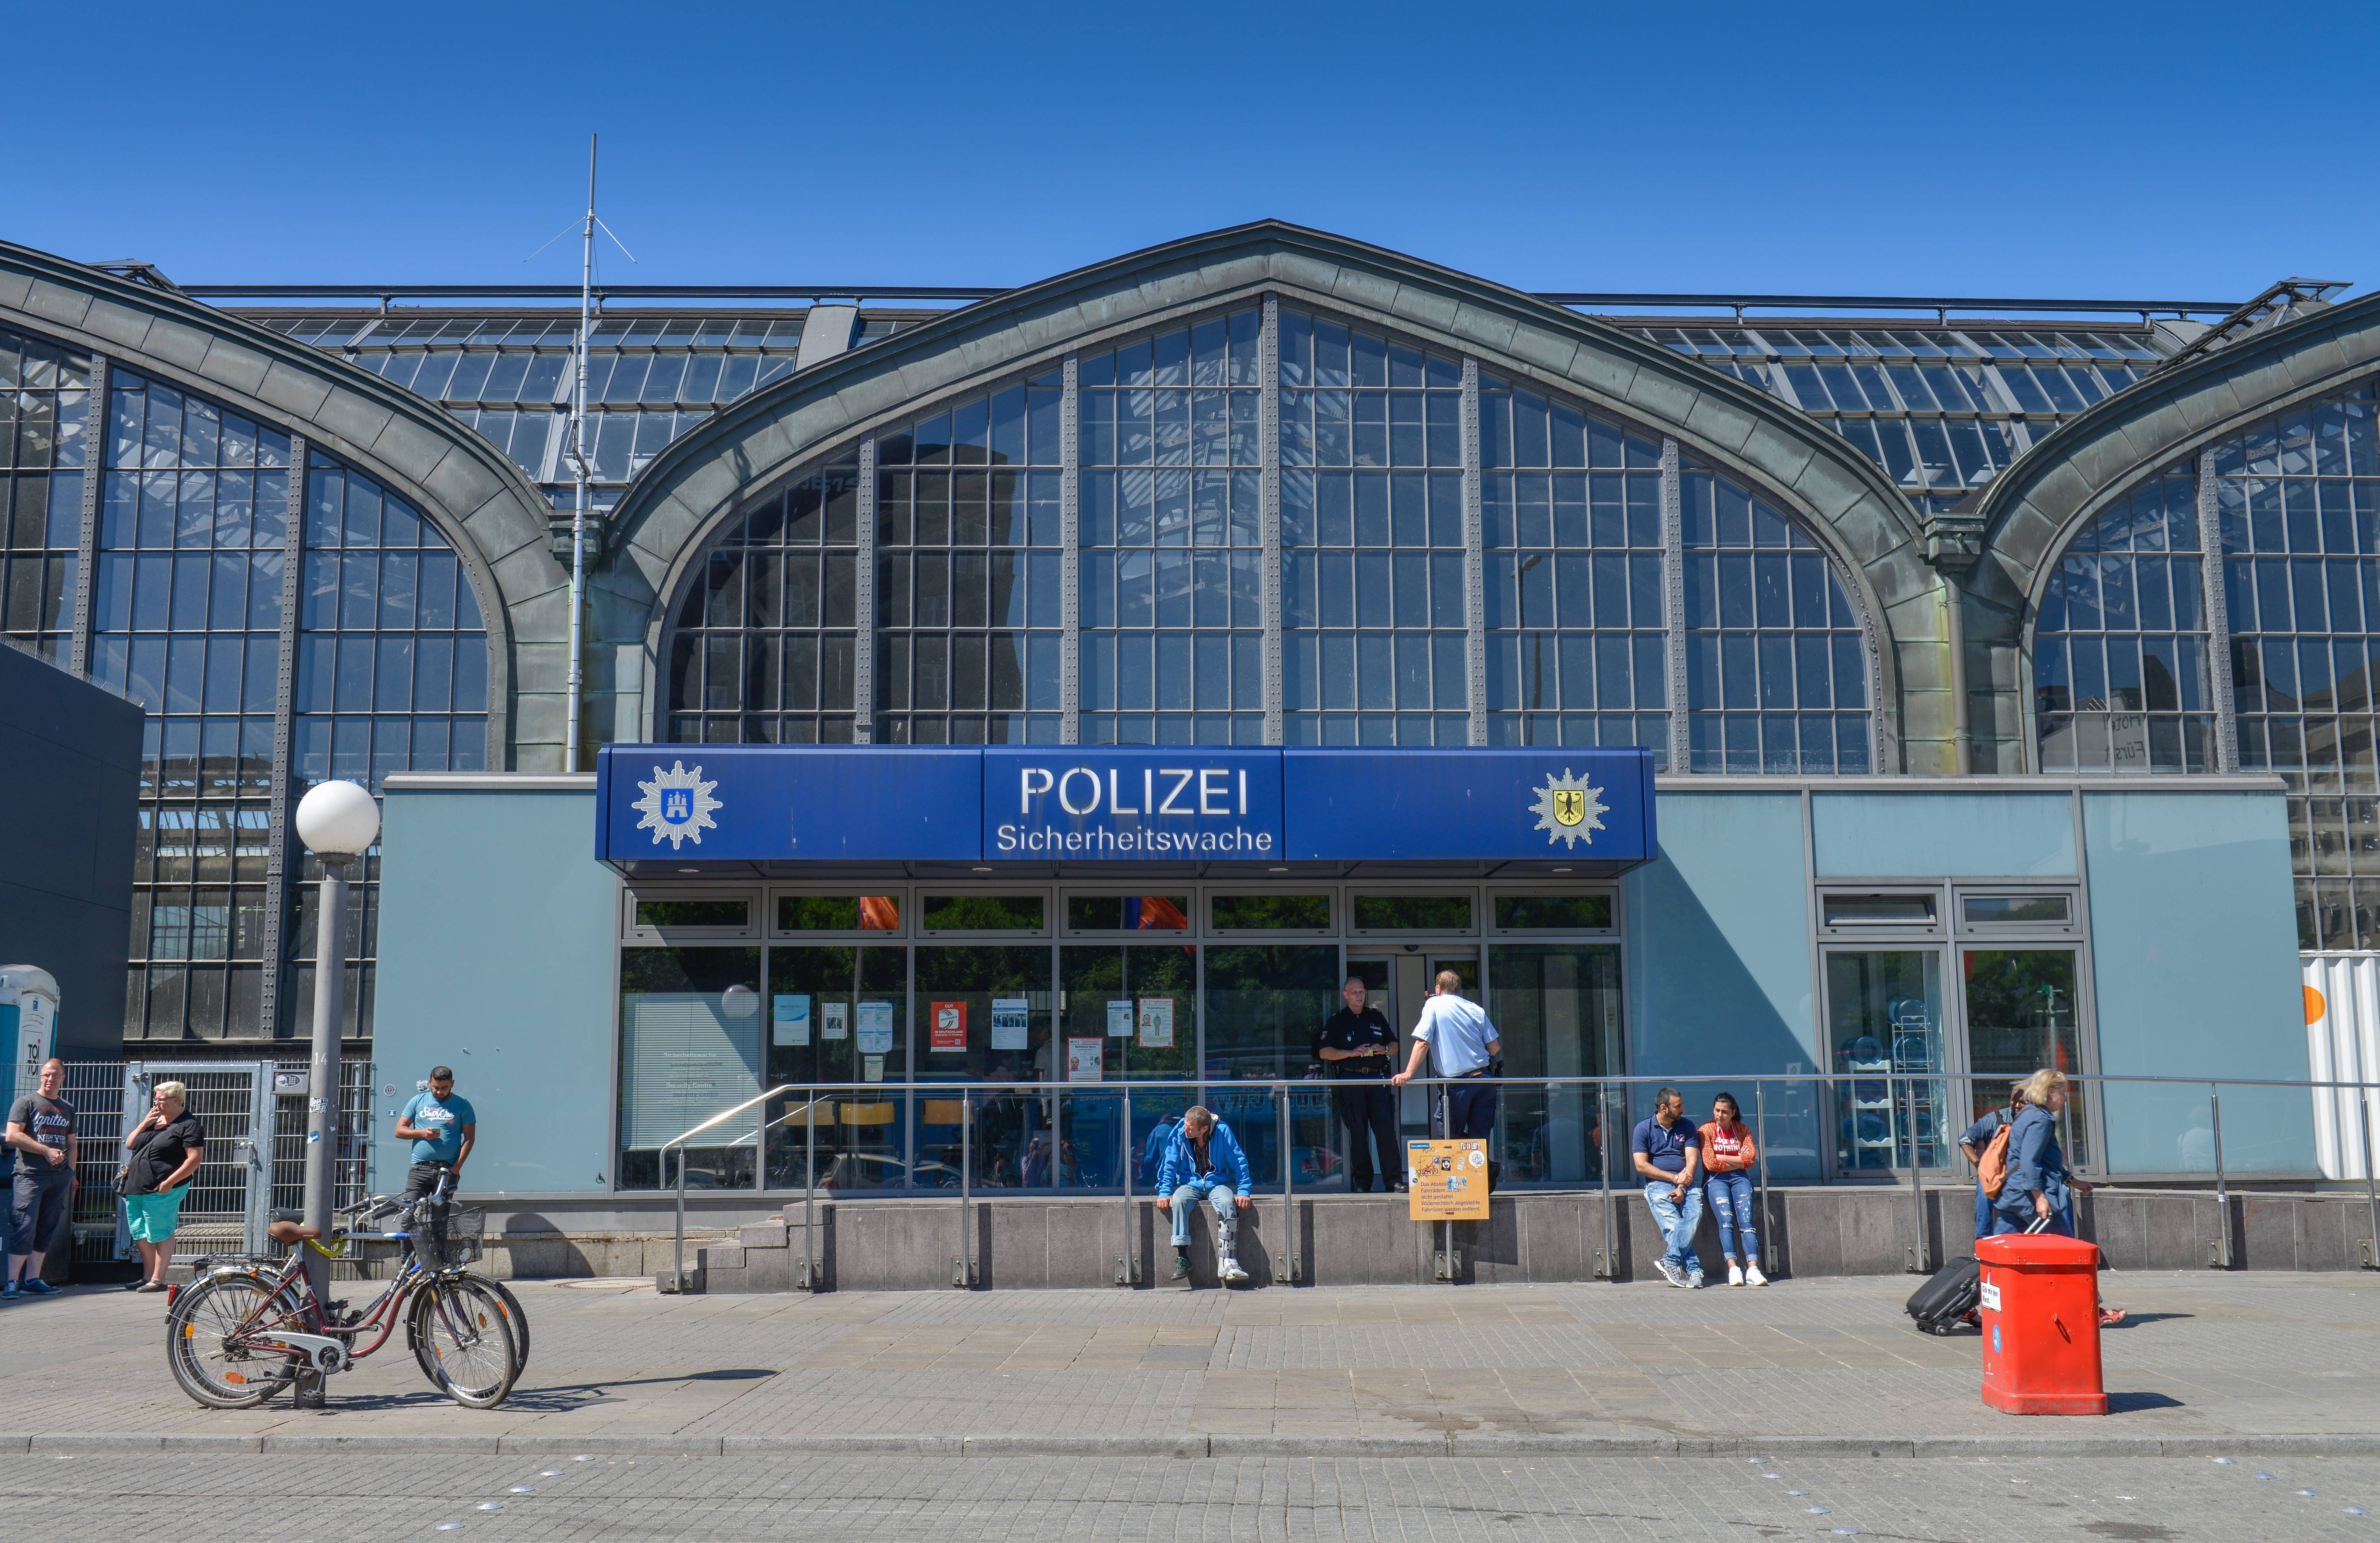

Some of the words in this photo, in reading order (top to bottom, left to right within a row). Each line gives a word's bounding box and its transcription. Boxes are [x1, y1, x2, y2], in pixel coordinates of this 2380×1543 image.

[1021, 767, 1246, 815] POLIZEI
[997, 824, 1272, 850] Sicherheitswache
[28, 1039, 40, 1059] TOI
[315, 1052, 327, 1065] 14
[37, 1134, 53, 1142] NEW
